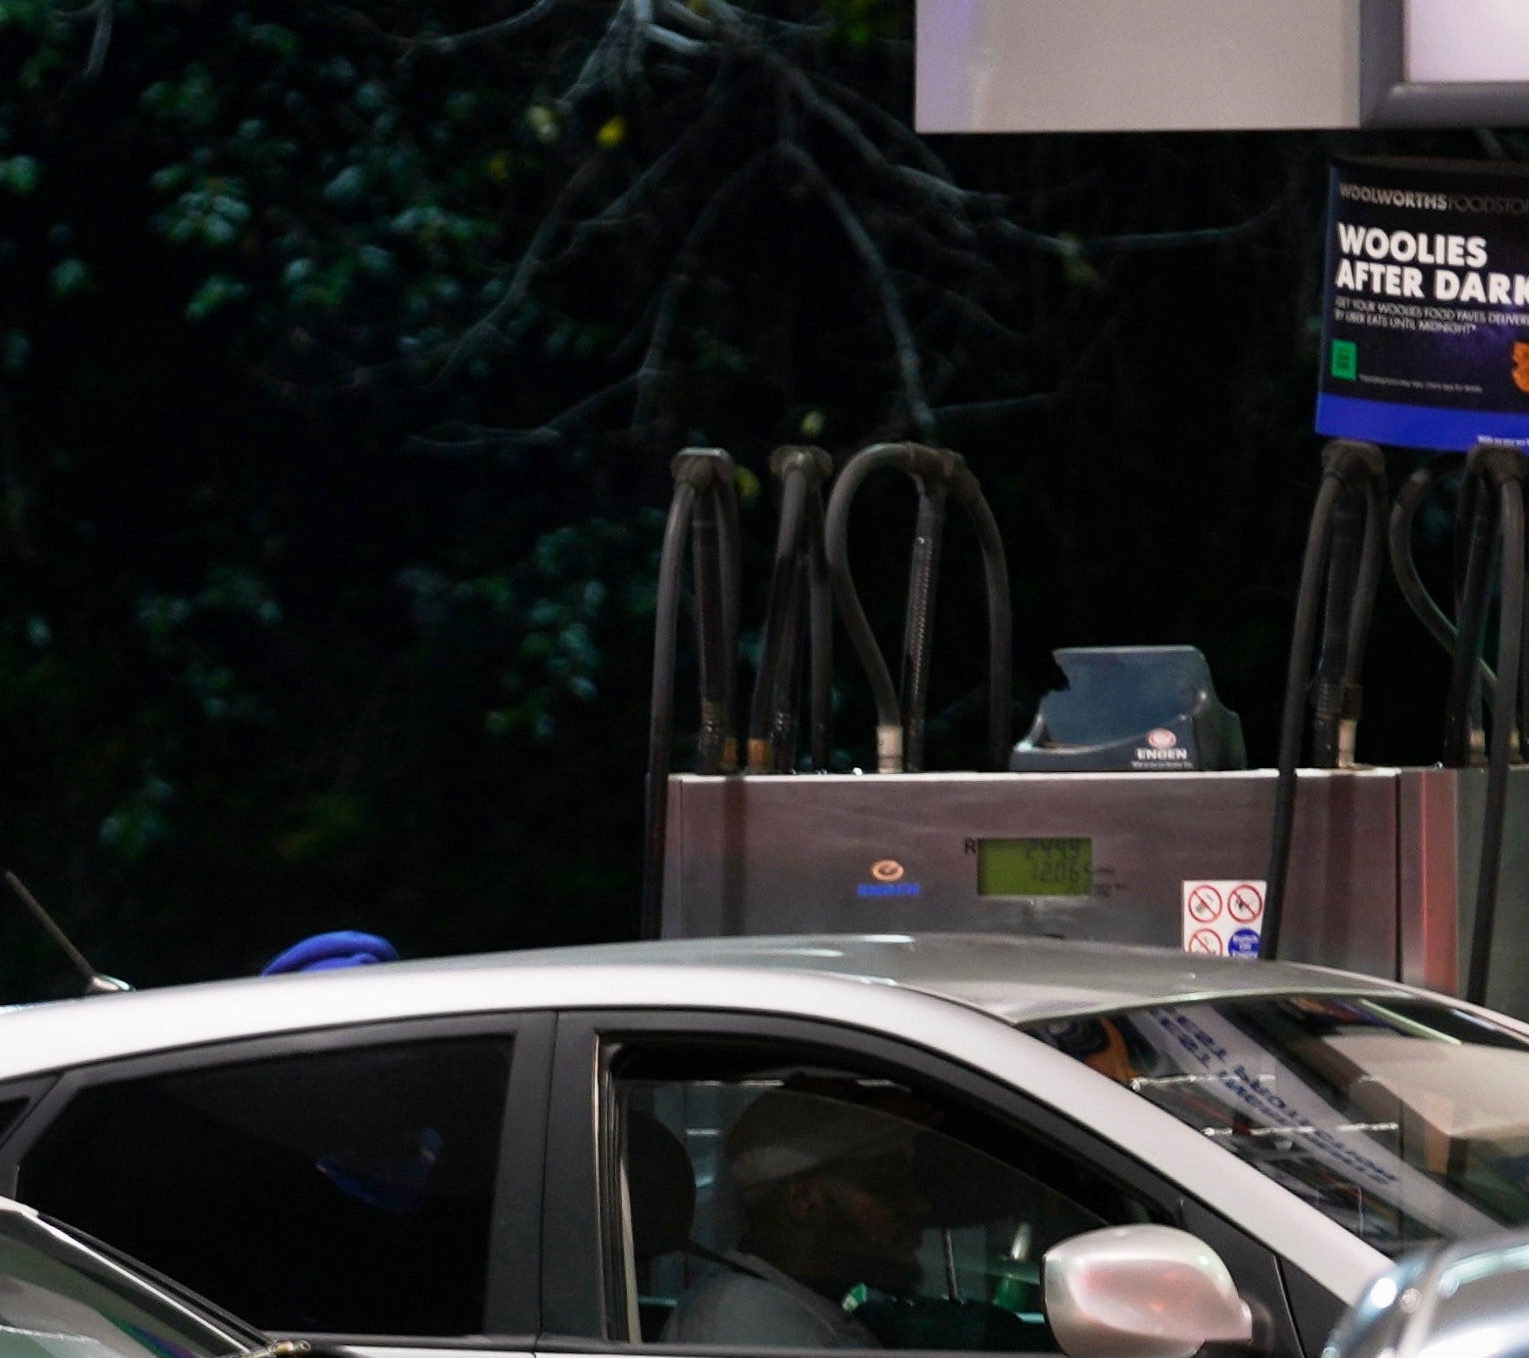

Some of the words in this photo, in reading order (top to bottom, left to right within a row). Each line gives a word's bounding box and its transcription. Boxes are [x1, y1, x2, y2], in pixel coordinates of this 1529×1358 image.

[1337, 222, 1489, 268] WOOLIES
[1335, 258, 1425, 299] AFTER
[964, 839, 976, 855] R
